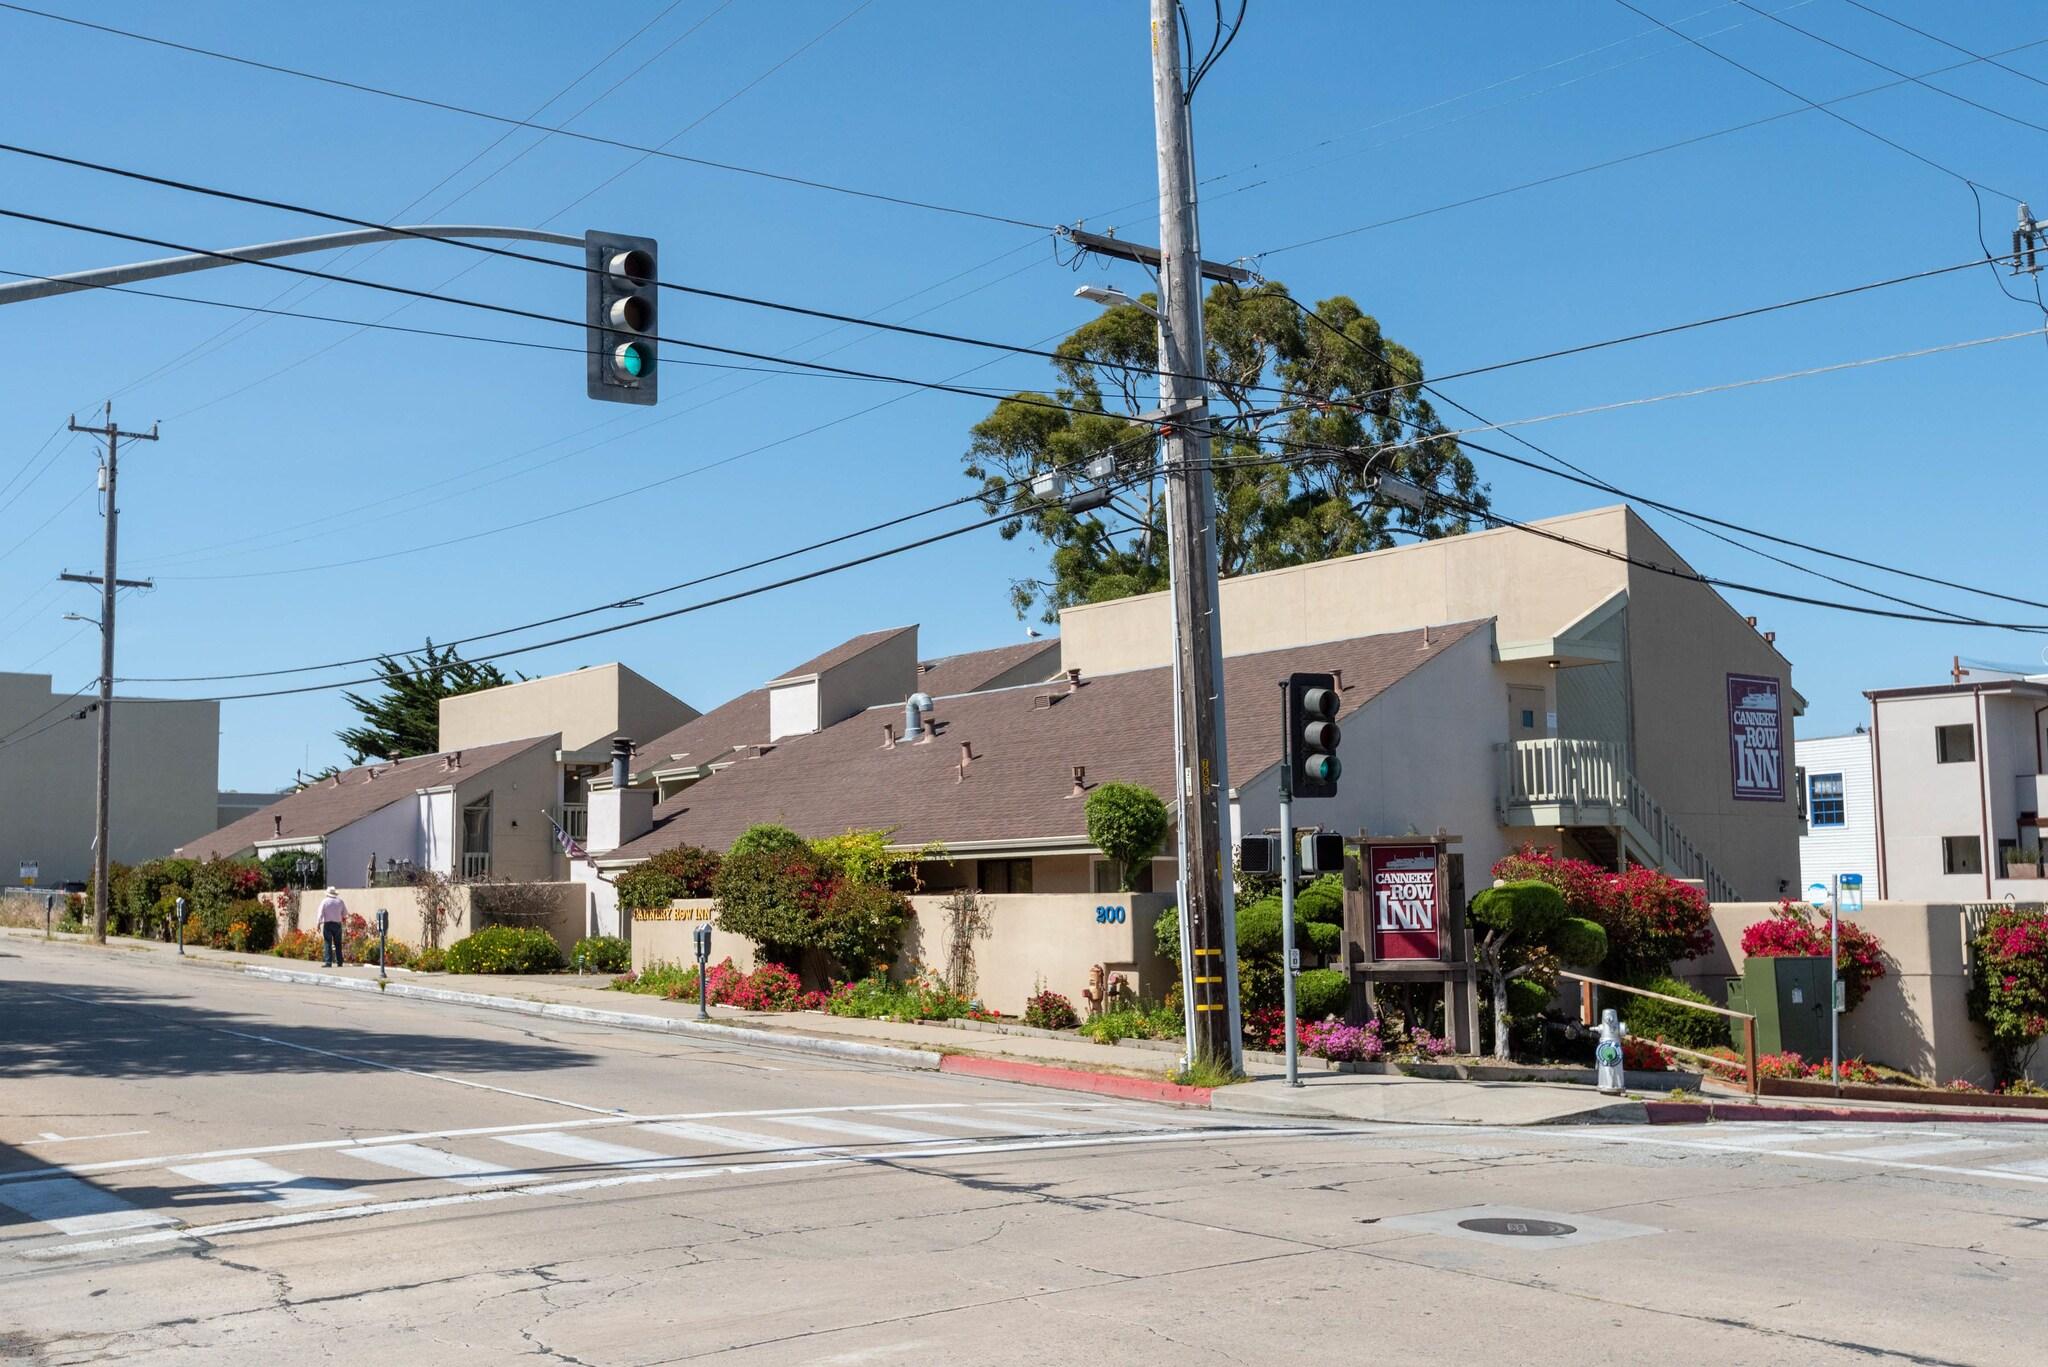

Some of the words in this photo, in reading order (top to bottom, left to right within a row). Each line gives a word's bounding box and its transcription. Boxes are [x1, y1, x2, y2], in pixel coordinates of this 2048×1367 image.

[1734, 710, 1776, 726] CANNERY
[1745, 726, 1777, 749] ROW
[1735, 734, 1778, 789] INN
[1376, 872, 1433, 885] CANNERY
[1390, 884, 1433, 900] ROW
[674, 908, 693, 921] ROW
[695, 907, 712, 921] INN
[1096, 905, 1126, 924] 200
[1376, 890, 1434, 930] INN
